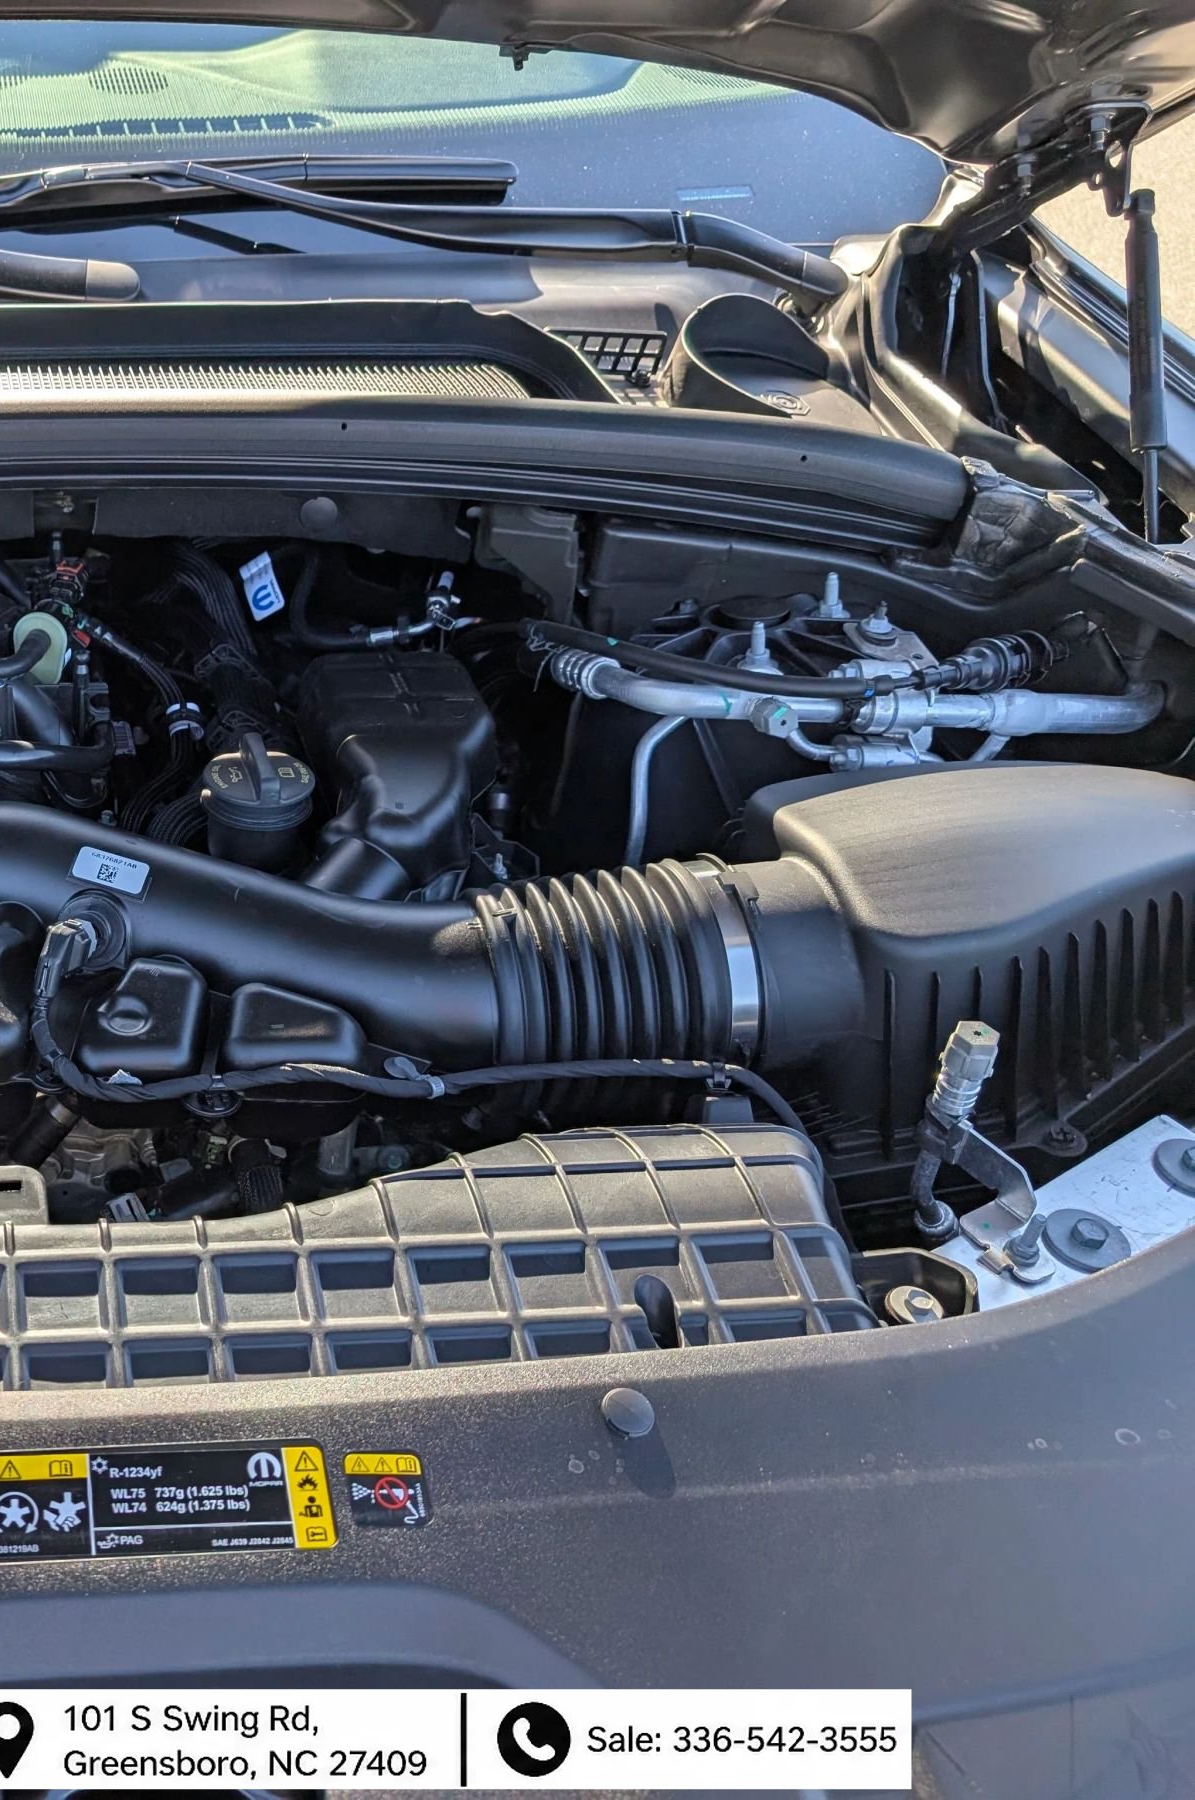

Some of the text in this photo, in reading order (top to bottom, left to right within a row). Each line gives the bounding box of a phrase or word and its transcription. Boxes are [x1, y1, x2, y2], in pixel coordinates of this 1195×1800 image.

[109, 1466, 163, 1479] R-1234yf
[110, 1485, 249, 1500] WL75 737g (1.625 lbs)
[111, 1498, 251, 1514] WL74 624g (1.375 lbs)
[119, 1535, 144, 1546] PAG
[211, 1539, 229, 1547] SAE
